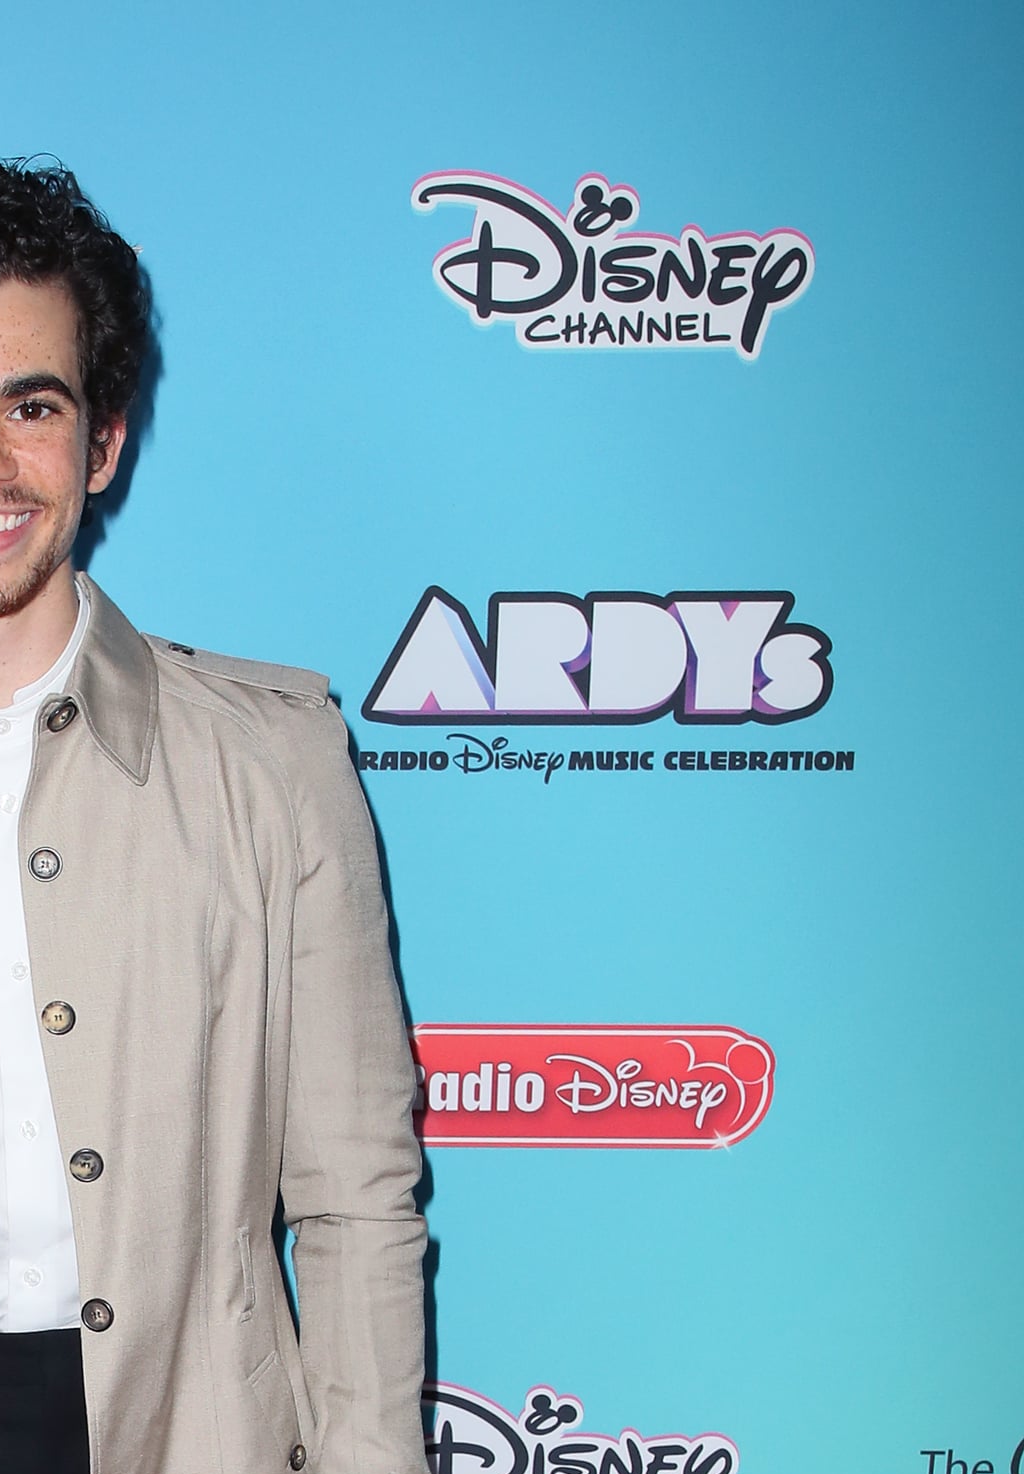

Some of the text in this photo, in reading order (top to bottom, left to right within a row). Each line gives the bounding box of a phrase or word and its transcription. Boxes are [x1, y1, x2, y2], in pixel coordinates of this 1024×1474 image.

[419, 183, 808, 353] Disney
[525, 311, 732, 345] CHANNEL
[358, 733, 855, 785] RADIO Disney MUSIC CELEBRATION
[546, 1053, 728, 1129] Disney
